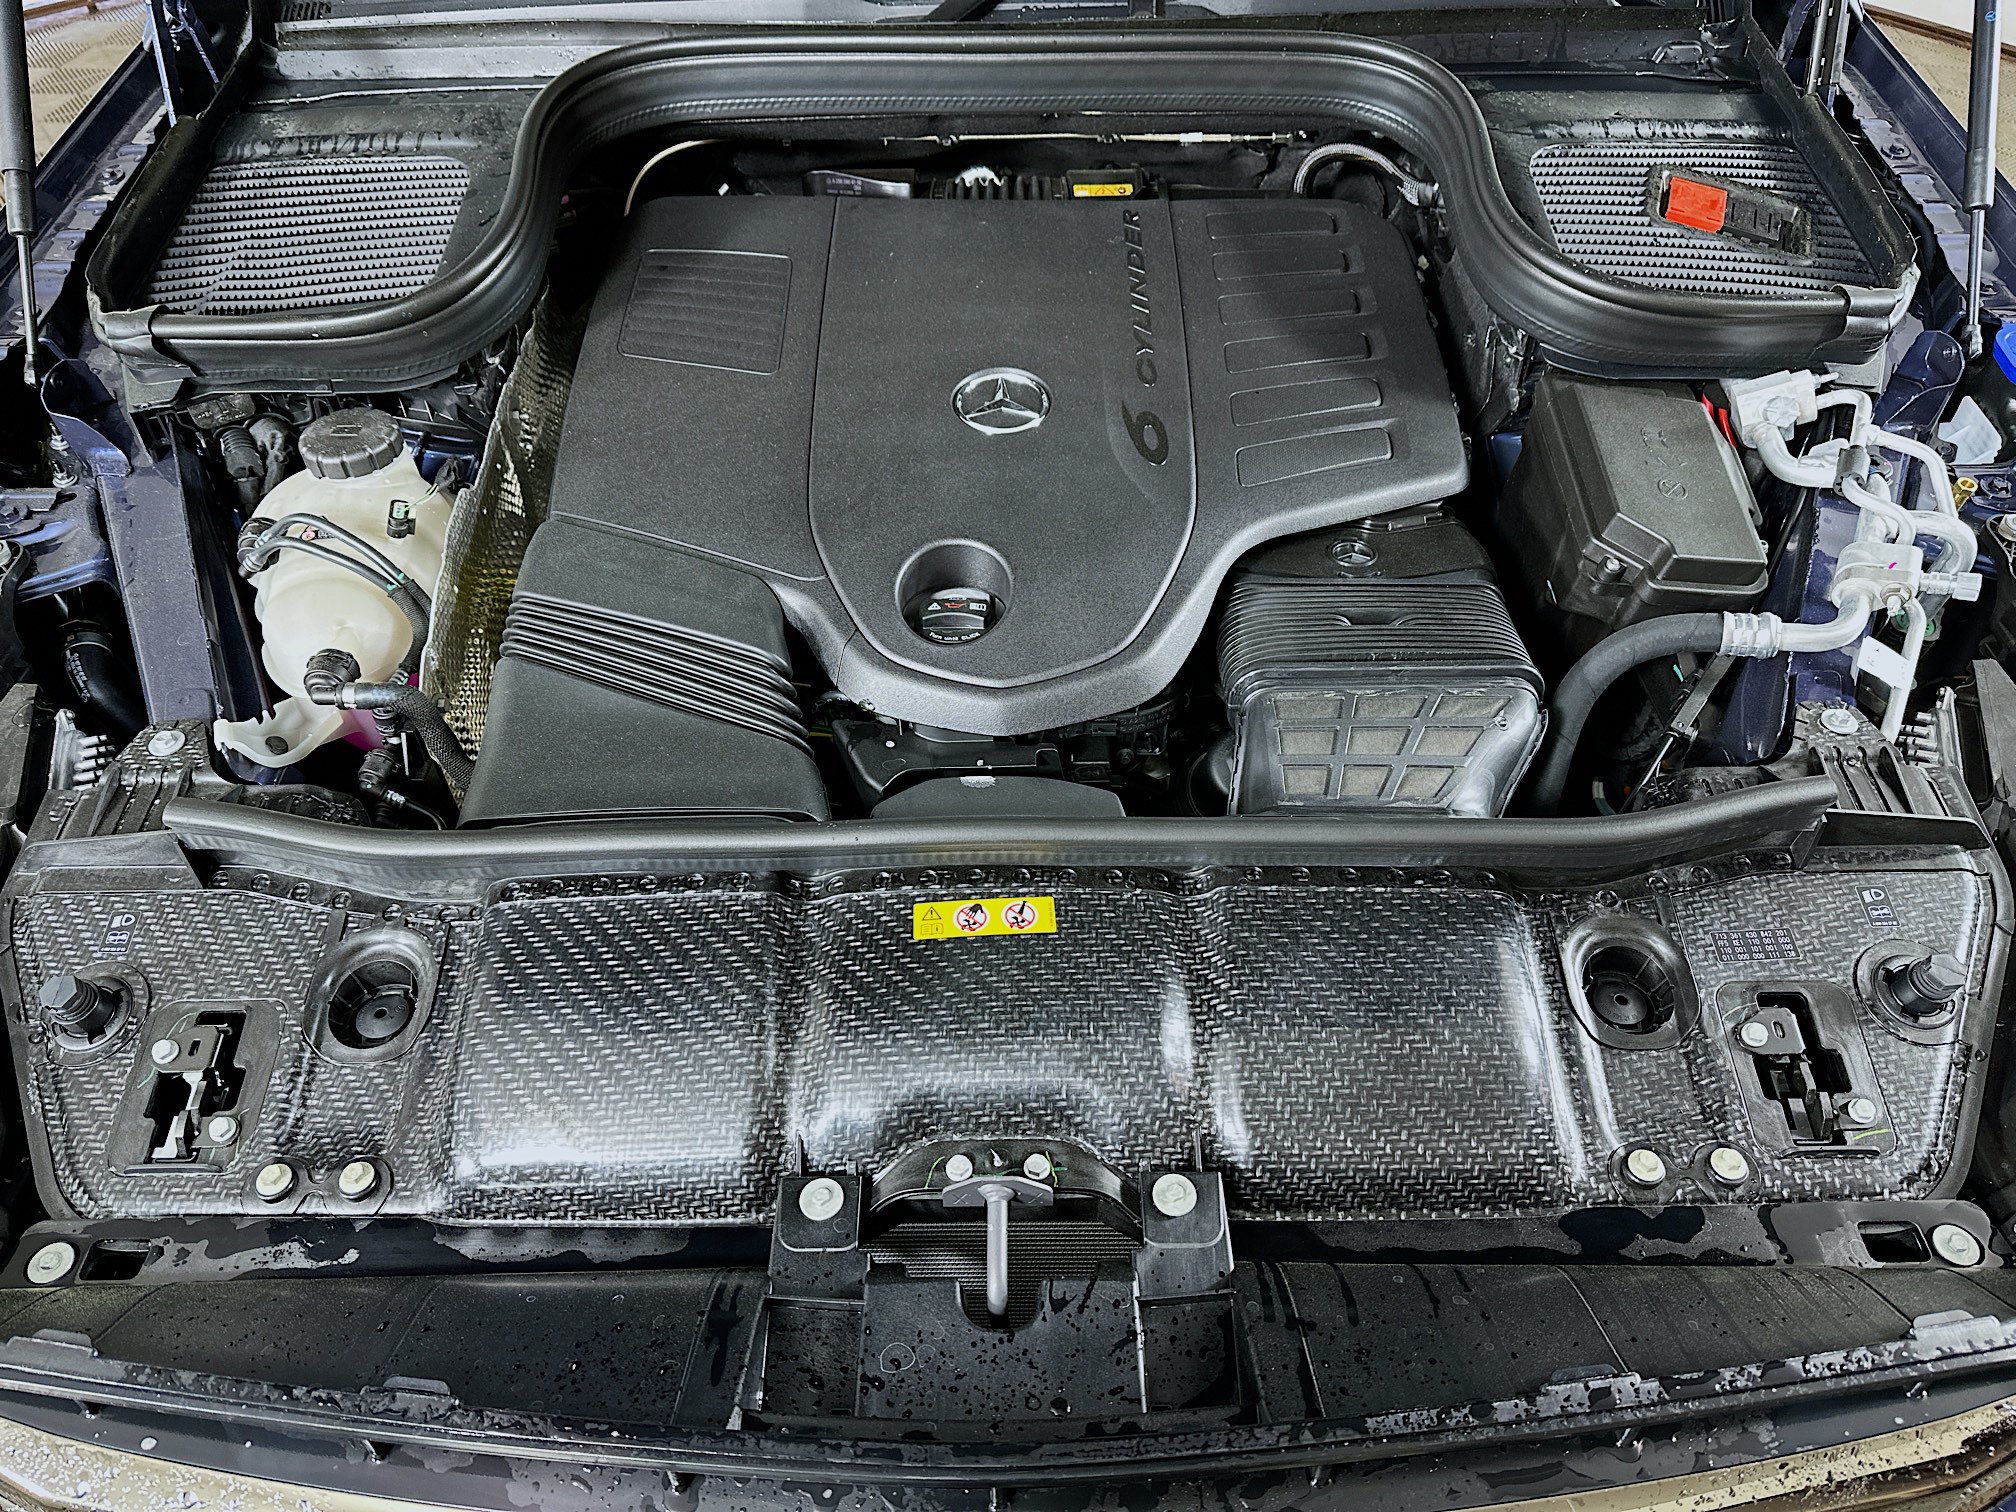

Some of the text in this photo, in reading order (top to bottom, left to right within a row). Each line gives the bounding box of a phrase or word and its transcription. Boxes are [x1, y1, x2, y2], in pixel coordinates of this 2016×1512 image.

[1121, 209, 1170, 466] 6 CYLINDER
[929, 632, 943, 640] Turn
[960, 632, 981, 641] CLICK
[1775, 929, 1788, 937] 201
[1717, 939, 1729, 947] FF5
[1777, 936, 1791, 944] 000
[1781, 943, 1794, 951] 100
[1737, 953, 1750, 961] 000
[1752, 952, 1765, 960] 000
[1768, 951, 1780, 959] 111
